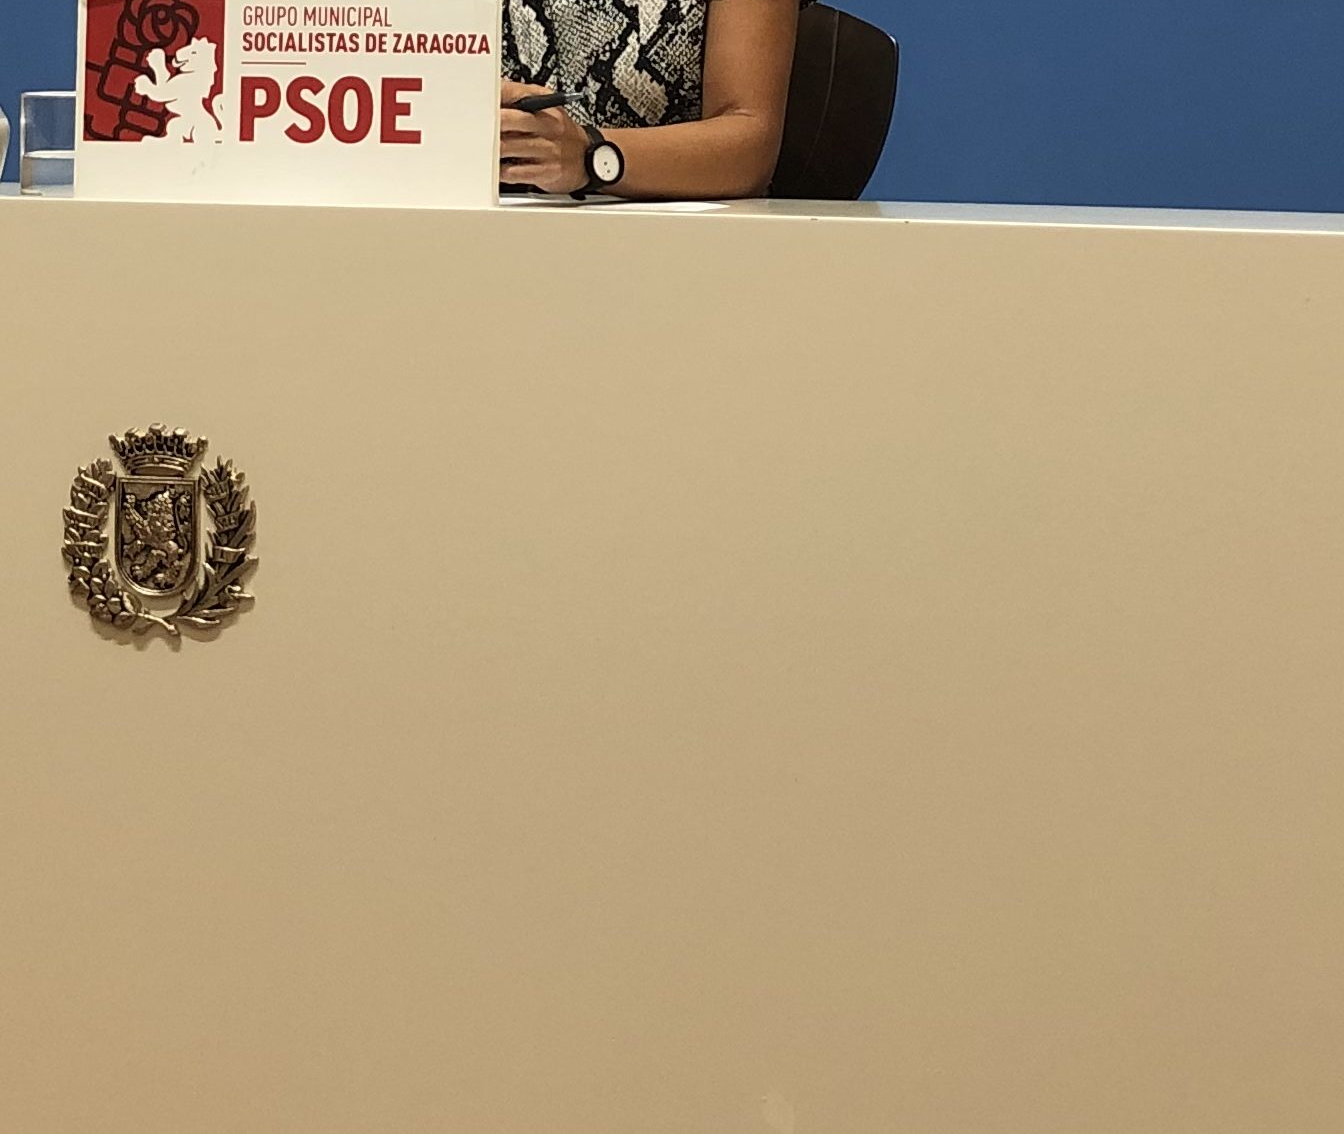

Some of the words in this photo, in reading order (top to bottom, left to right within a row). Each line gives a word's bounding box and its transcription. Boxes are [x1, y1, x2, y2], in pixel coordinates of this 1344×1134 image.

[242, 5, 298, 27] GRUPO
[303, 6, 393, 27] MUNICIPAL
[242, 32, 359, 53] SOCIALISTAS
[364, 33, 388, 53] DE
[392, 33, 491, 55] ZARAGOZA
[239, 75, 423, 144] PSOE
